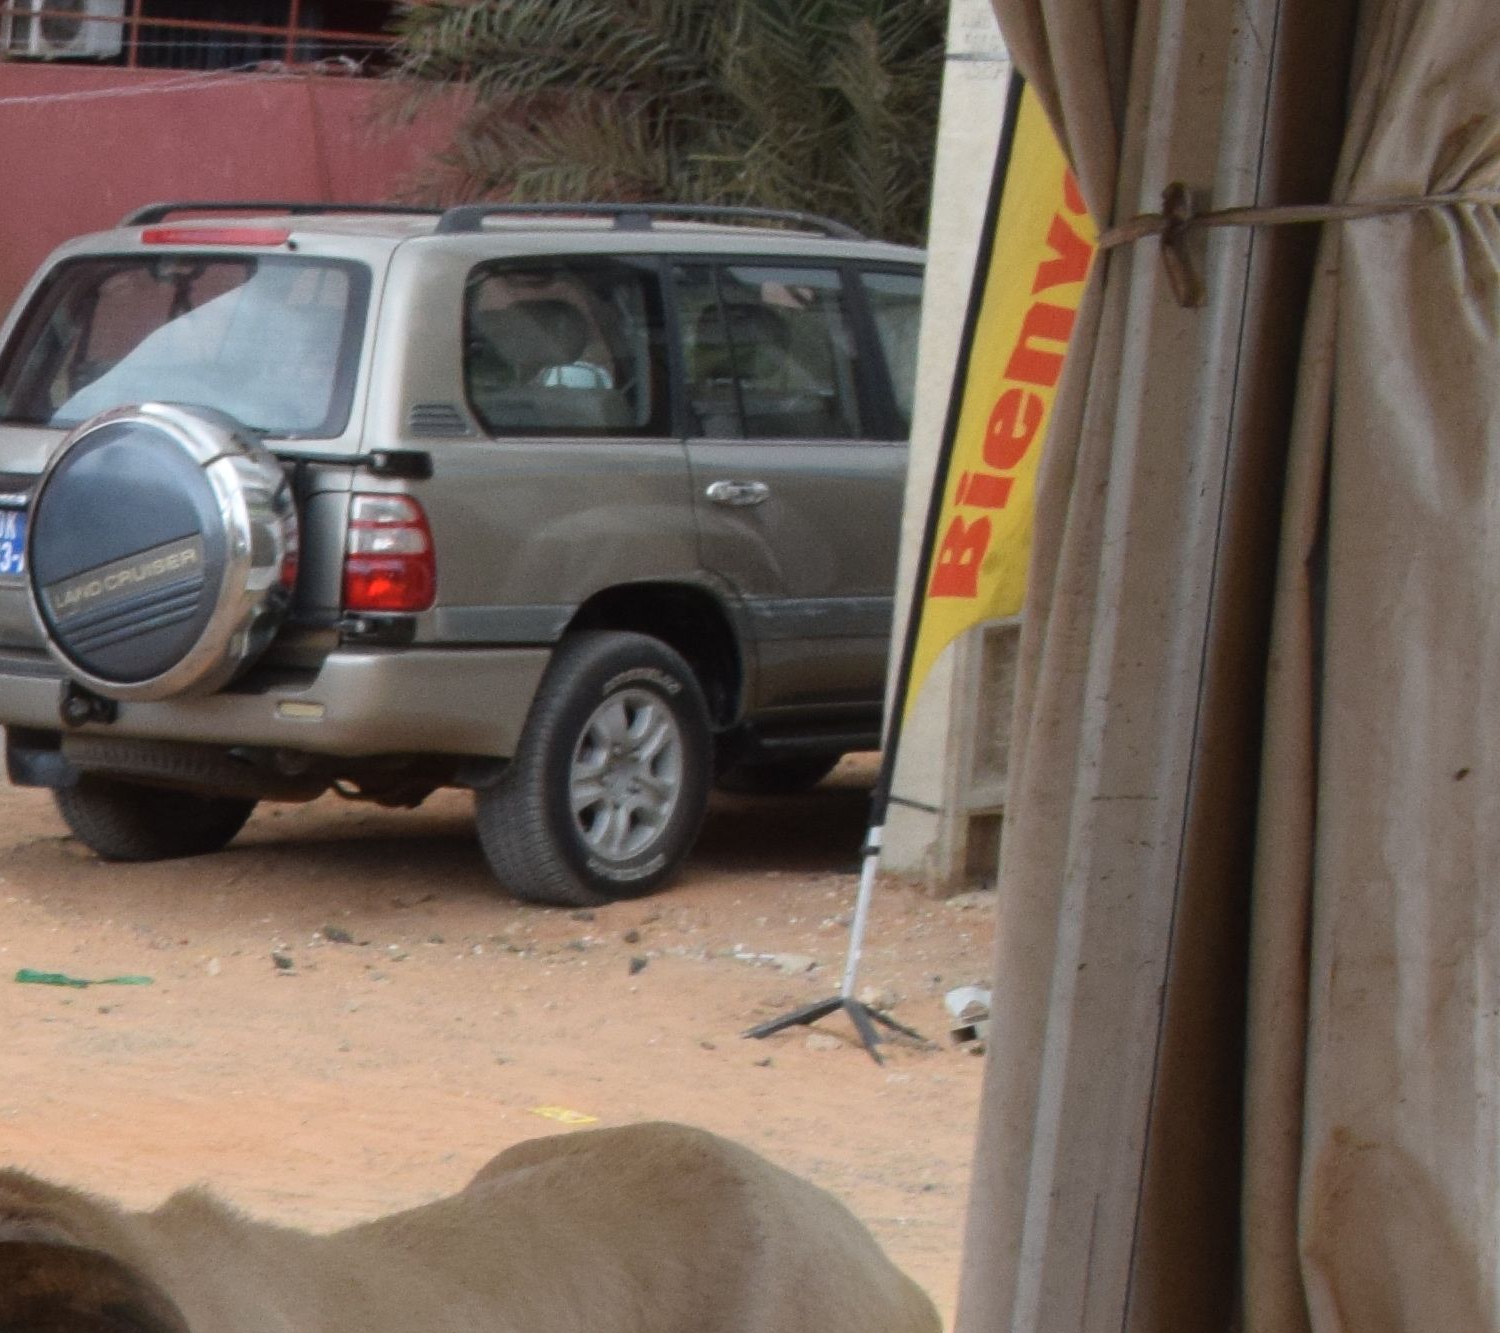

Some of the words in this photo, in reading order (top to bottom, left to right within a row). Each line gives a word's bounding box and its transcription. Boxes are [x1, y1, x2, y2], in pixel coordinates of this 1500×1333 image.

[928, 166, 1094, 598] Bienv
[53, 581, 101, 609] LAND
[104, 549, 196, 590] CRUISER
